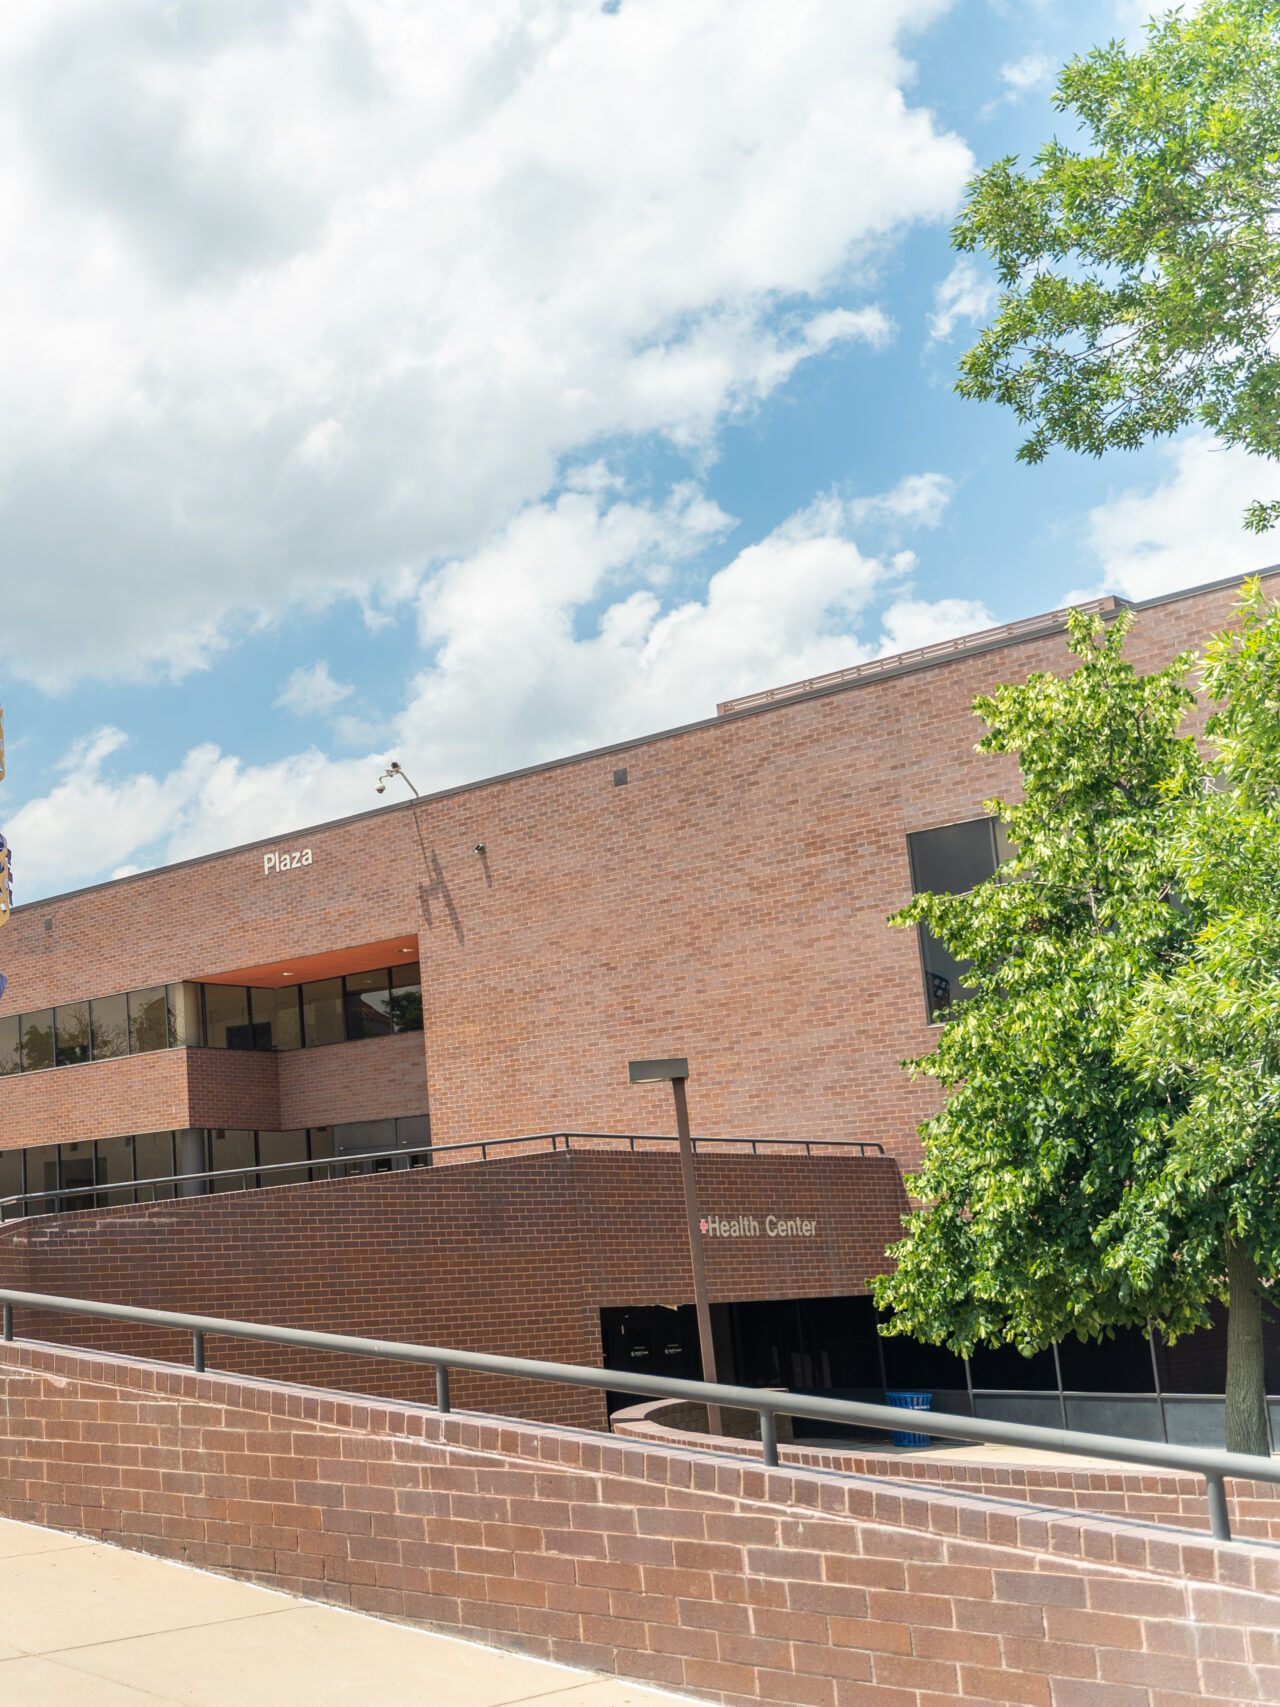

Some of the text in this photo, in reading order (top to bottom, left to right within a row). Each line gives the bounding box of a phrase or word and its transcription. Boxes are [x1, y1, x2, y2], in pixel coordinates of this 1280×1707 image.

[263, 848, 313, 875] Plaza
[707, 1214, 817, 1237] Health Center
